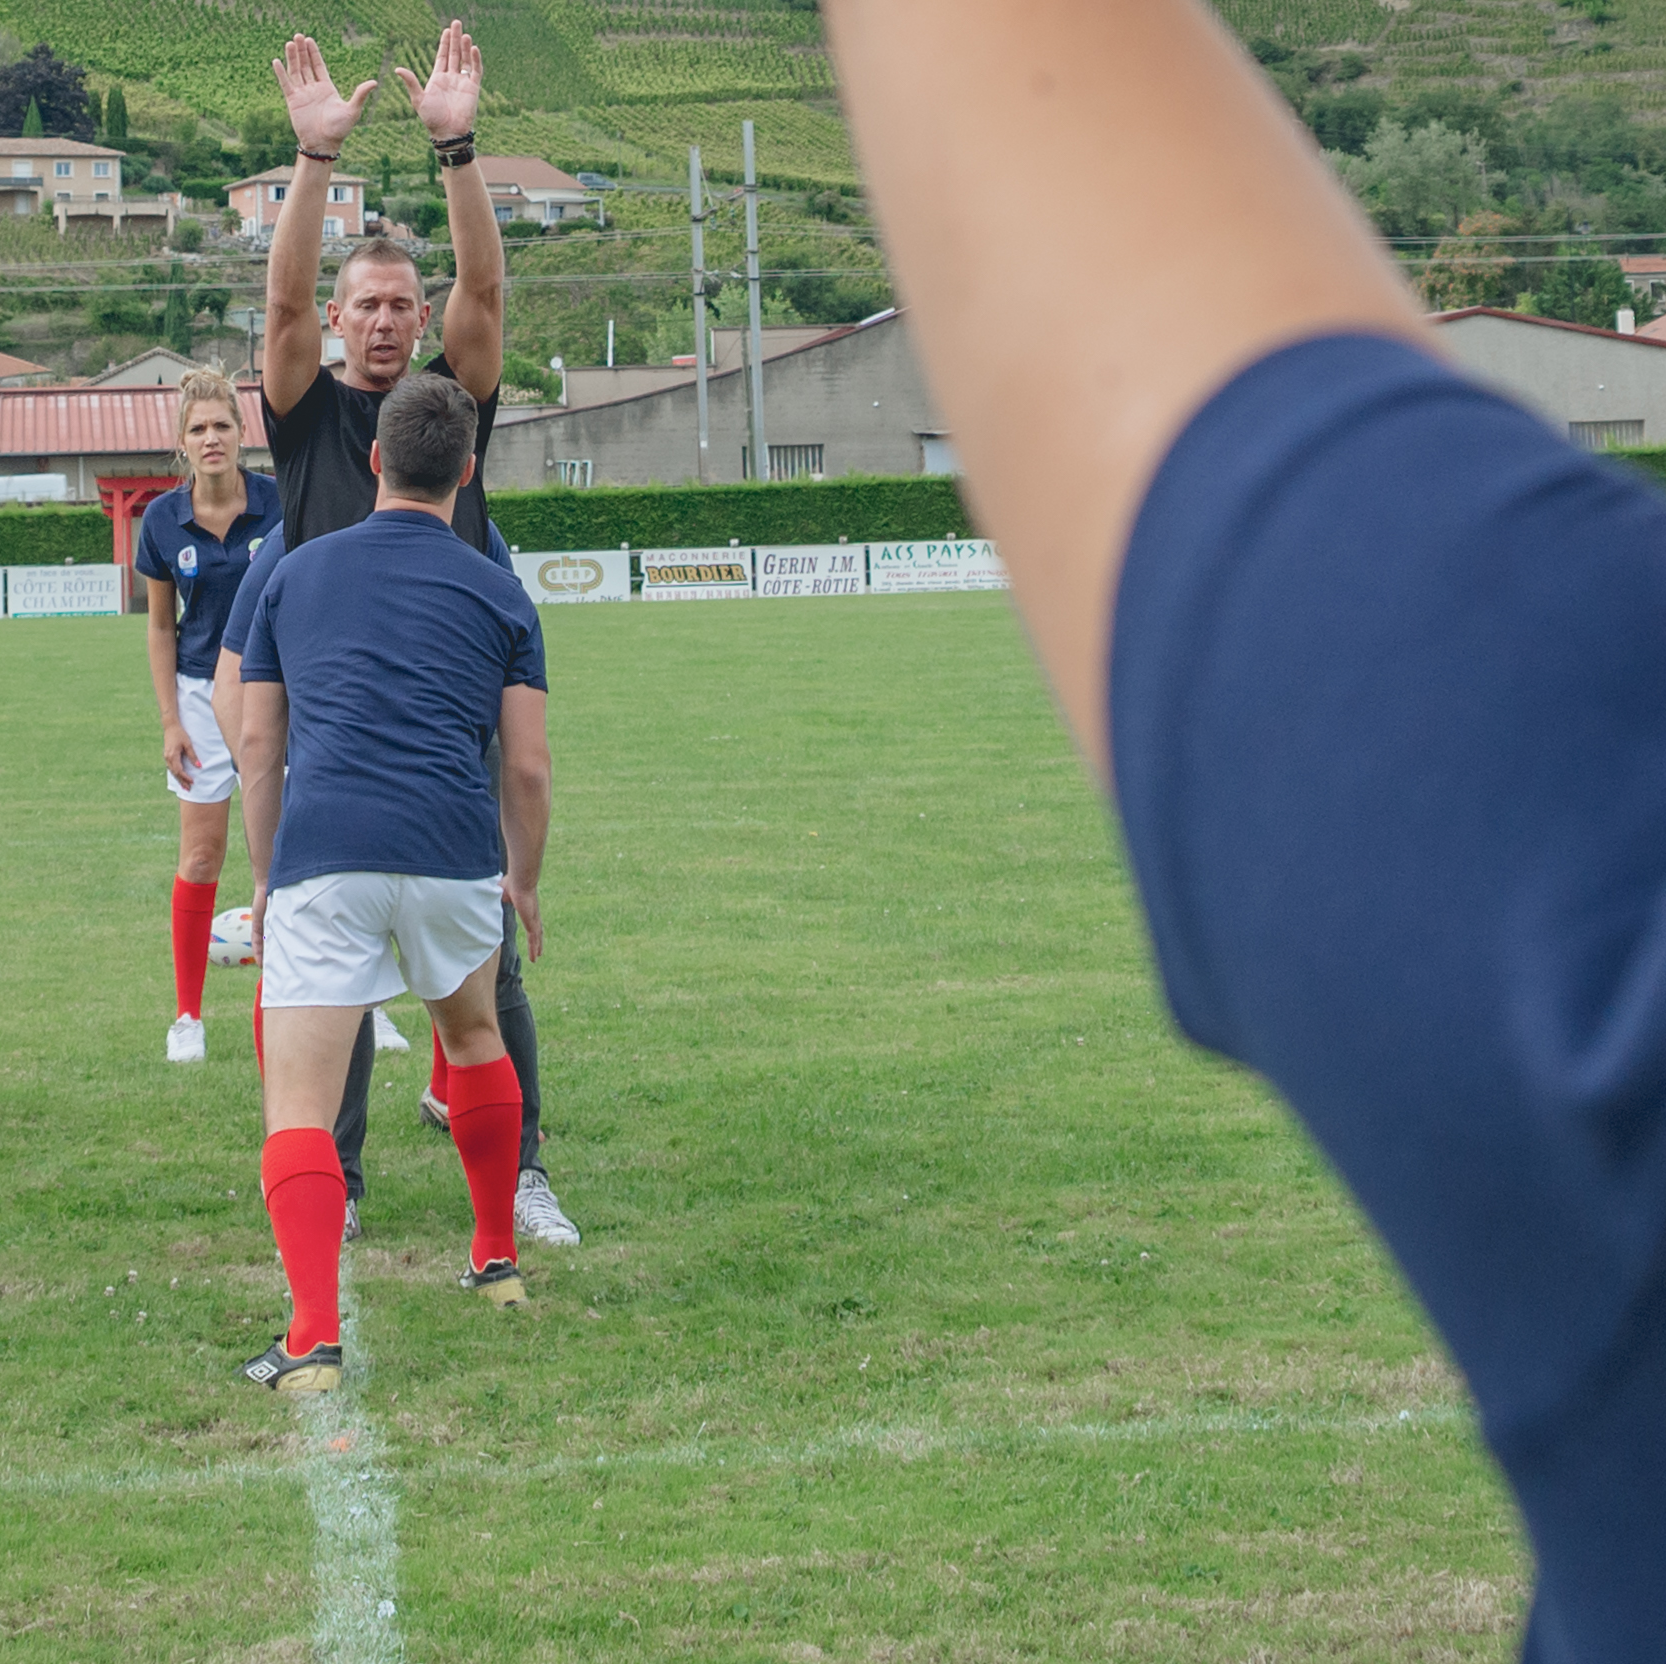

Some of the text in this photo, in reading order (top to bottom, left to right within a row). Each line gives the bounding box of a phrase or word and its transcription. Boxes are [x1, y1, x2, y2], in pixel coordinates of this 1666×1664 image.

[645, 551, 746, 562] MACONNERIE
[881, 544, 914, 560] ACS
[828, 555, 858, 574] J.M.
[550, 569, 592, 581] SERP
[645, 563, 748, 584] BOURDIER
[13, 576, 116, 595] CÔTE RÔTIE
[22, 595, 108, 609] CHAMPET
